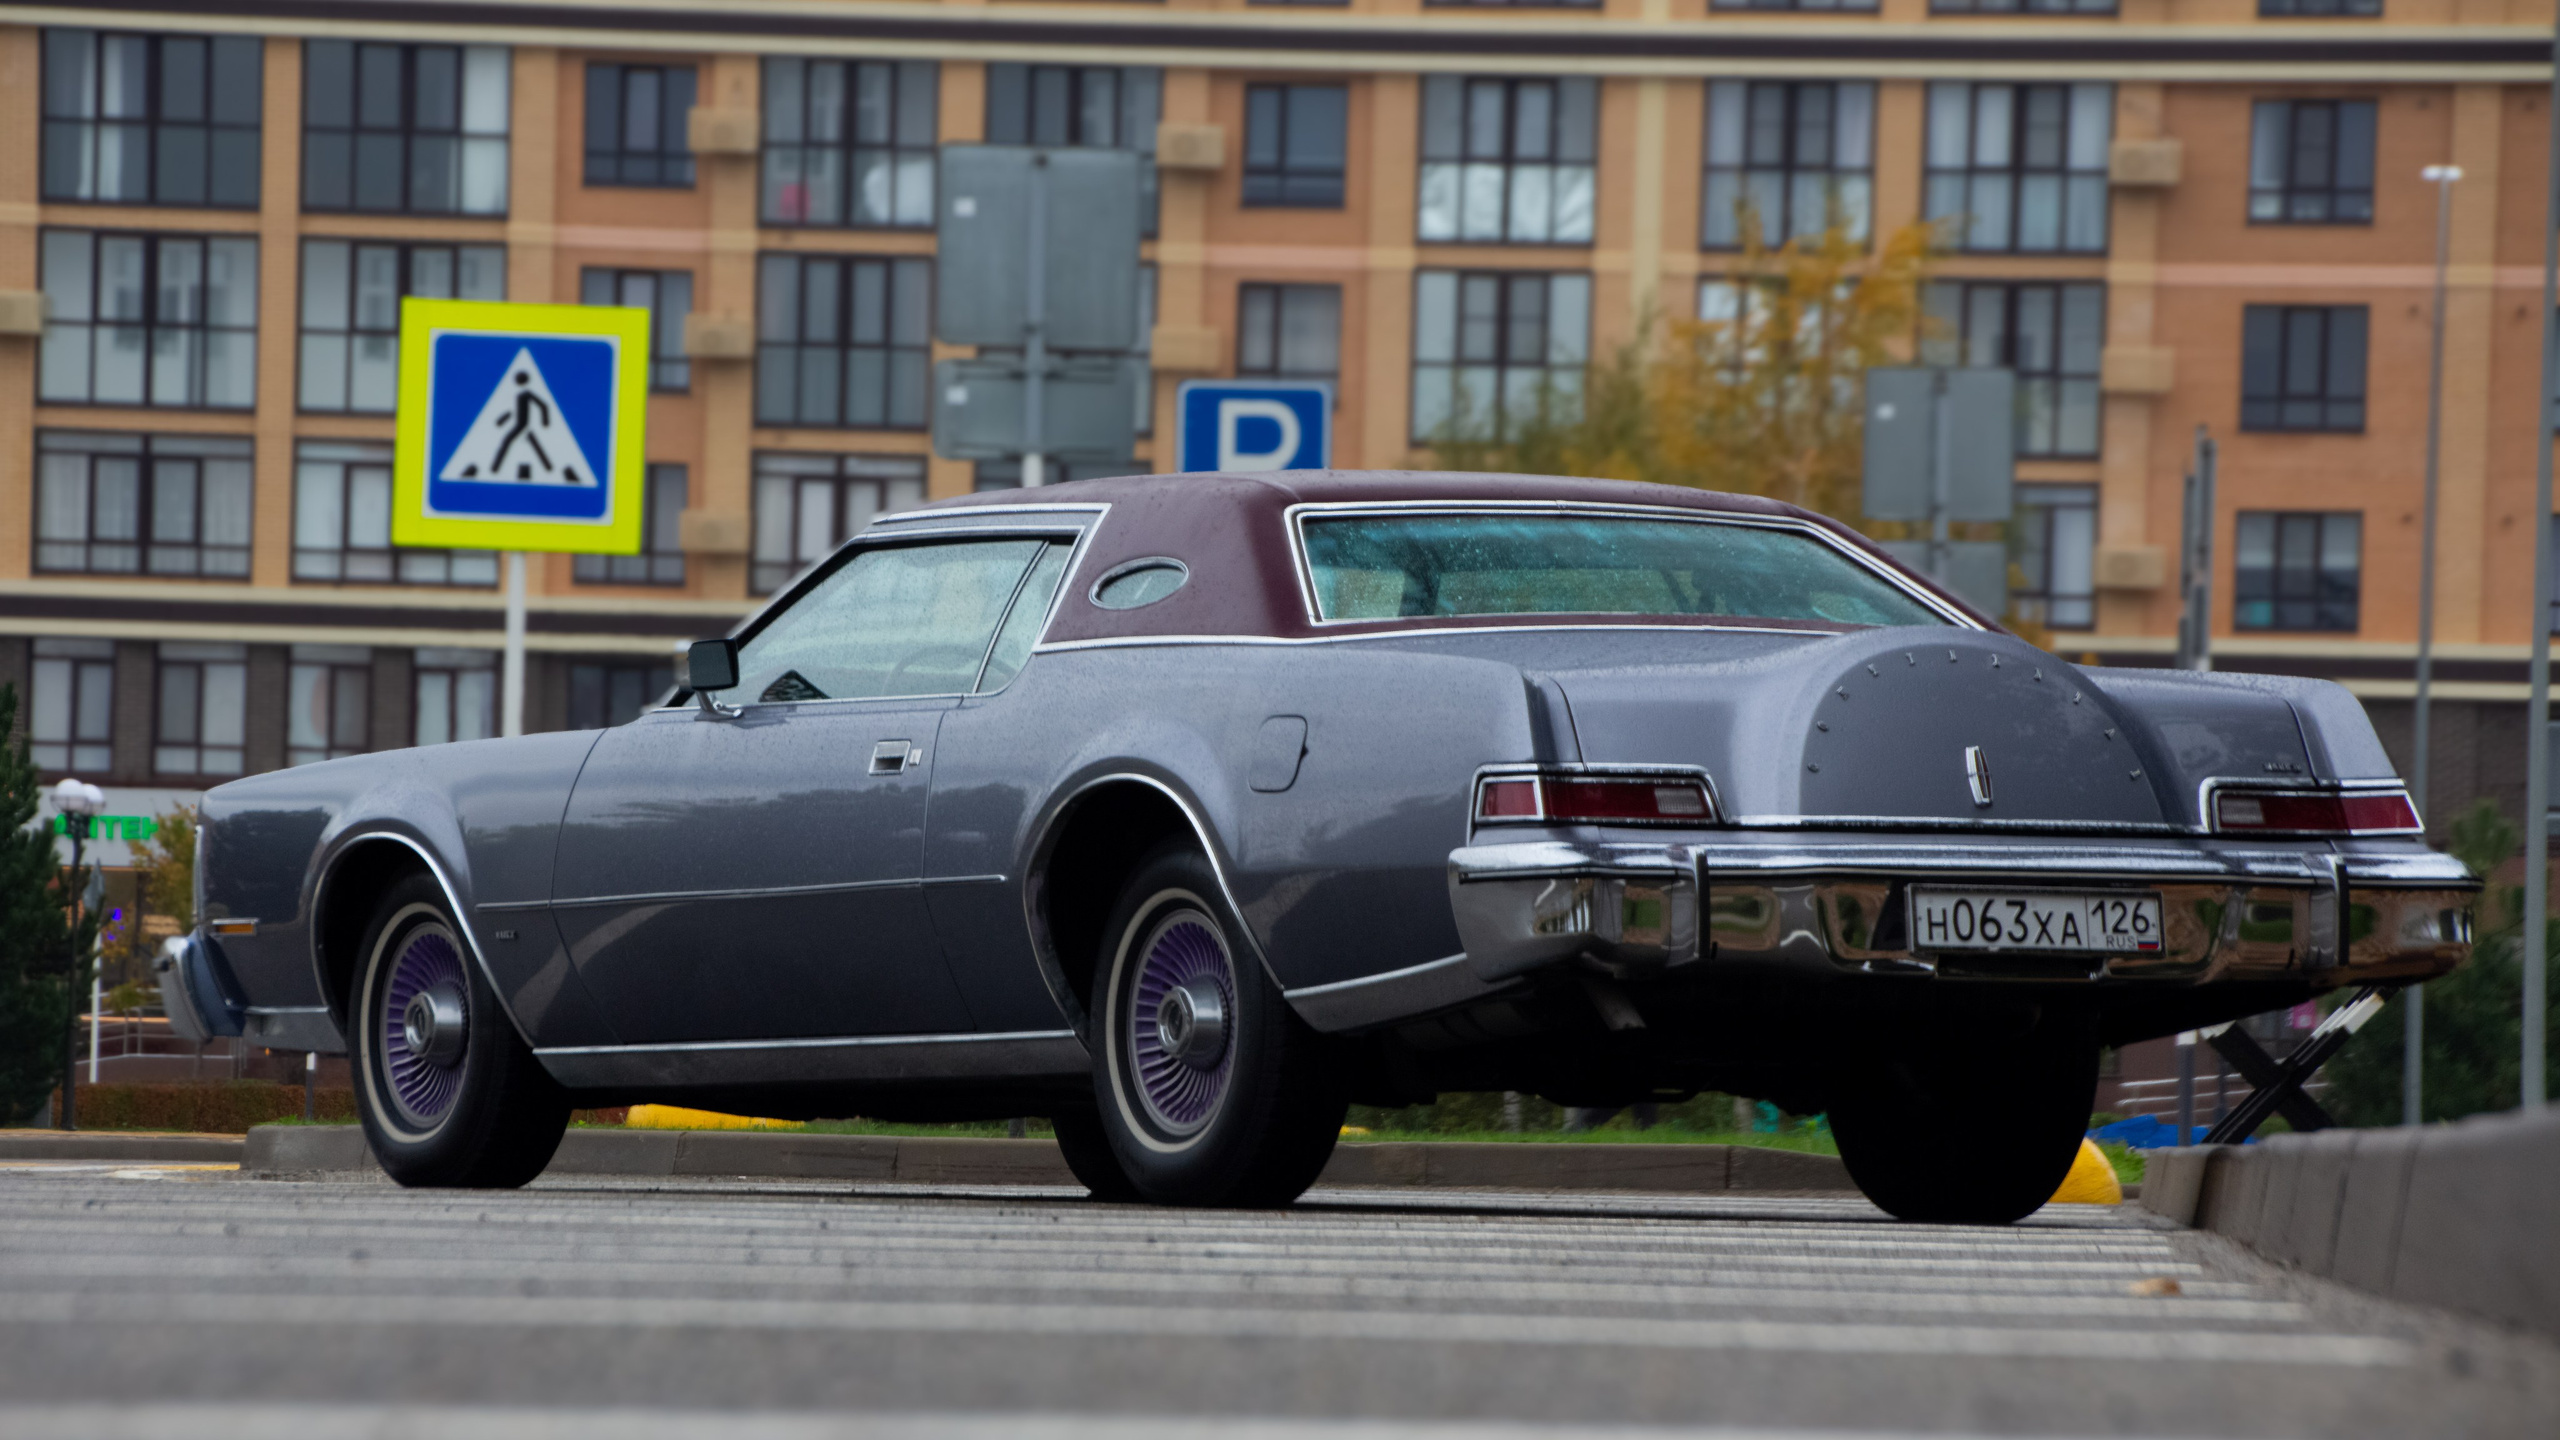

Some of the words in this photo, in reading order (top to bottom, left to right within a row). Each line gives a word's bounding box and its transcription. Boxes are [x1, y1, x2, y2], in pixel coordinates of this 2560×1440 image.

[1217, 398, 1302, 472] P
[1926, 898, 2082, 946] Н063ХА
[2091, 899, 2151, 935] 126
[2105, 935, 2137, 949] RUS
